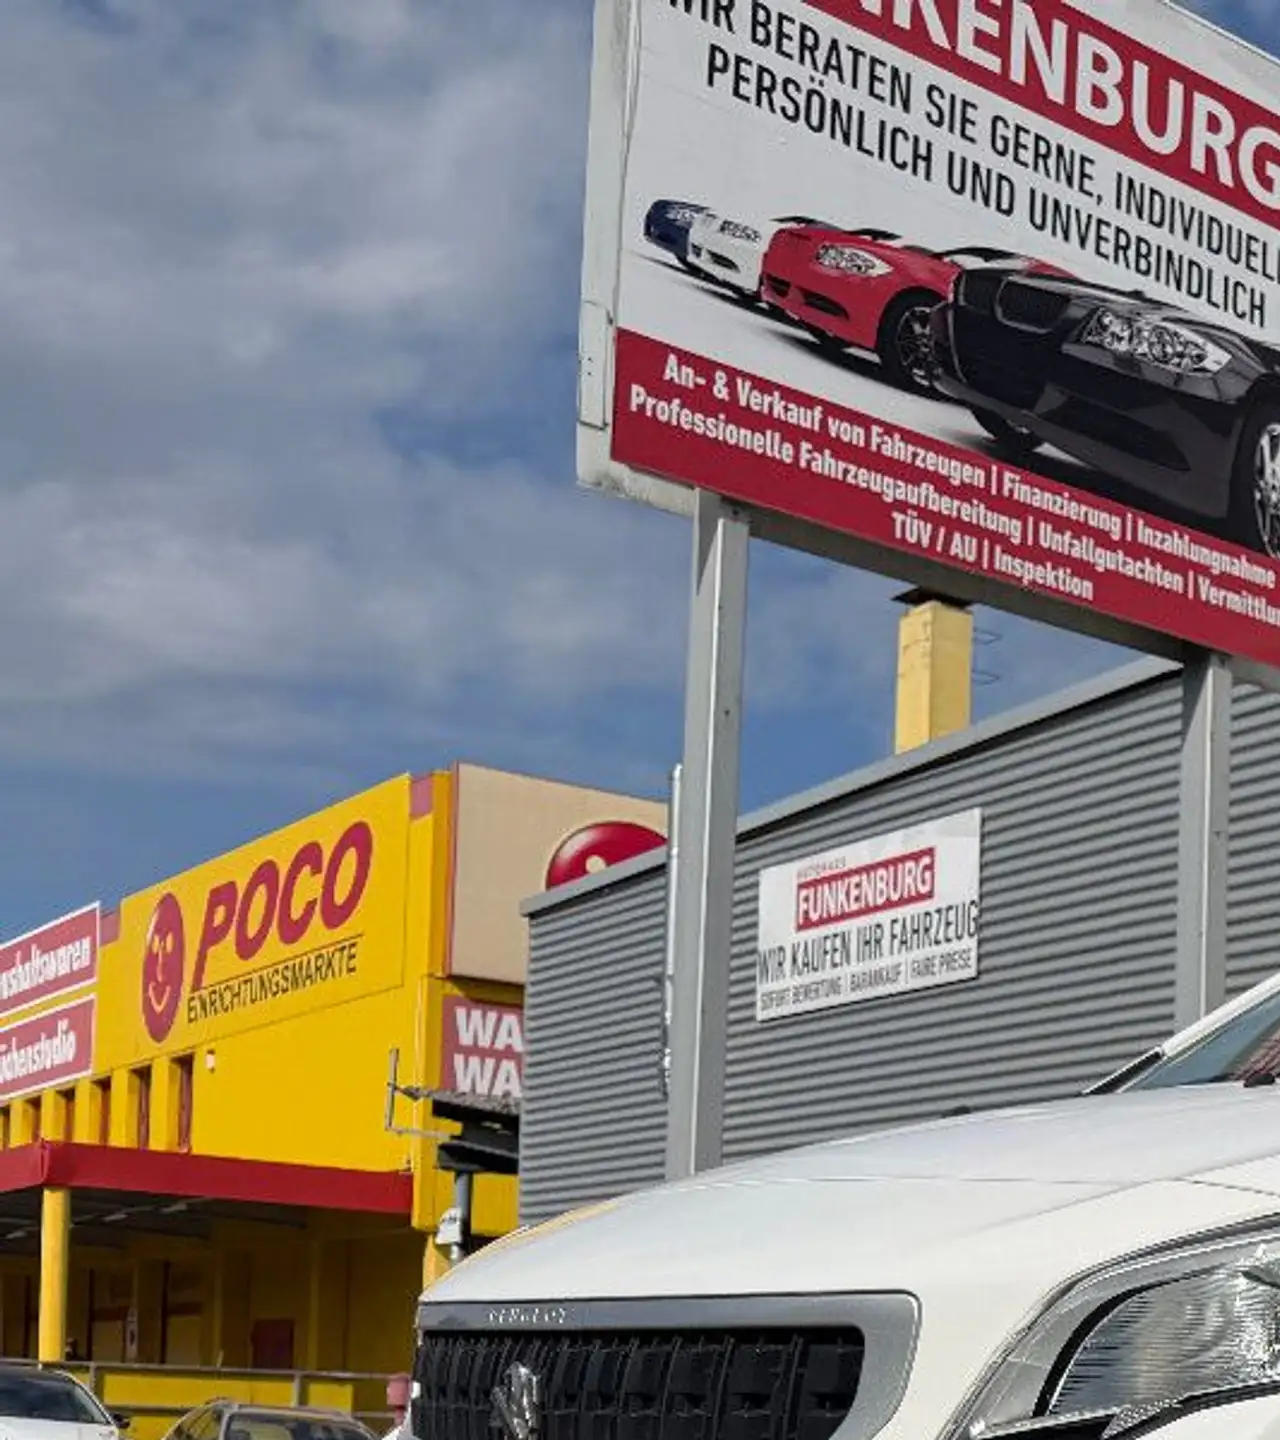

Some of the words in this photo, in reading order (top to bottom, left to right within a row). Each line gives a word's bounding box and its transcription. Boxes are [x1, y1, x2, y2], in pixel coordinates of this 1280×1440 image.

[707, 43, 933, 183] PERSÖNLICH
[946, 150, 1015, 218] UND
[1028, 187, 1266, 328] UNVERBINDLICH
[750, 2, 911, 114] BERATEN
[925, 84, 978, 144] SIE
[990, 115, 1102, 206] GERNE,
[630, 383, 793, 464] Professionelle
[800, 442, 1021, 545] Fahrzeugaufbereitung
[1039, 521, 1184, 594] Unfallgutachten
[663, 353, 706, 389] An-
[712, 370, 731, 401] &
[737, 376, 824, 432] Verkauf
[828, 417, 865, 448] von
[871, 425, 986, 488] Fahrzeugen
[1003, 470, 1122, 541] Finanzierung
[1137, 518, 1277, 589] Inzahlungnahme
[892, 510, 932, 551] TÜV
[949, 531, 978, 566] AU
[994, 545, 1094, 601] Inspektion
[191, 821, 373, 994] POCO
[757, 945, 787, 984] WIR
[789, 931, 851, 976] KAUFEN
[856, 923, 885, 964] IHR
[890, 900, 980, 953] FAHRZEUG
[798, 855, 933, 925] FUNKENBURG
